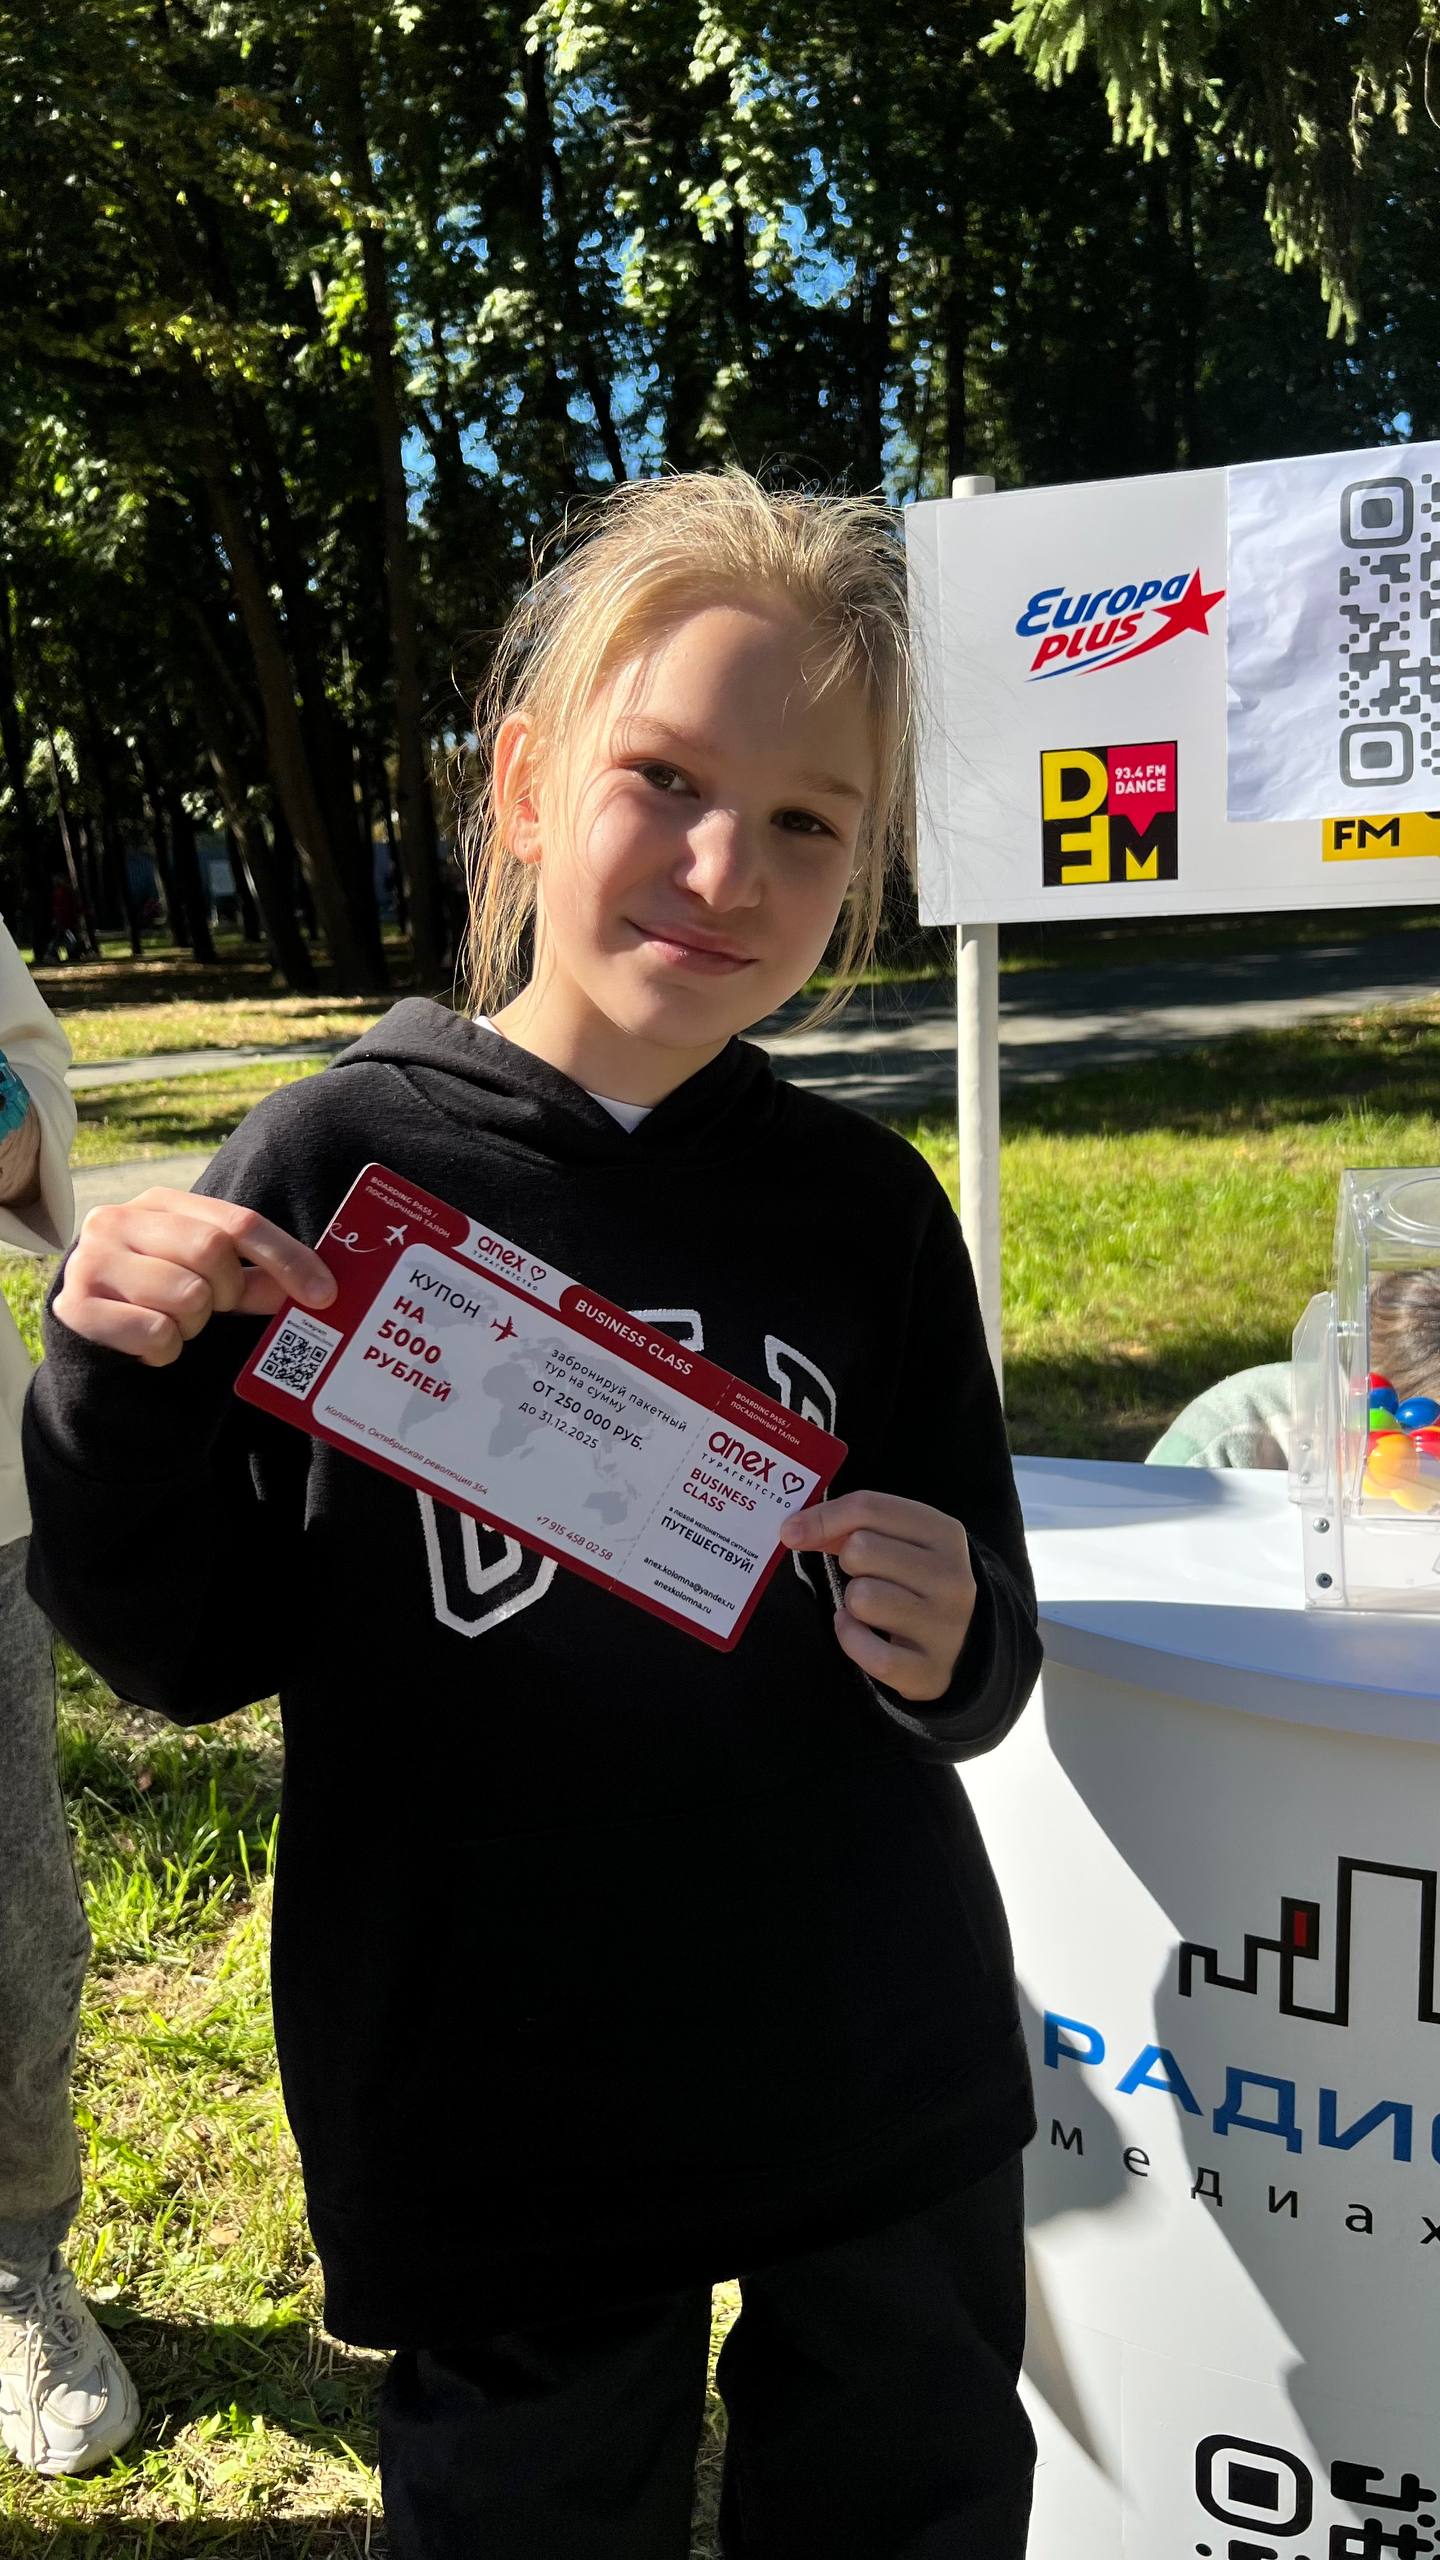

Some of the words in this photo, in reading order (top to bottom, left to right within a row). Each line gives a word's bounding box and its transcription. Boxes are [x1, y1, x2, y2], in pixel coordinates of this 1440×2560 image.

[1114, 766, 1143, 780] 93.4
[1146, 764, 1167, 777] FM
[1115, 778, 1167, 795] DANCE
[1333, 817, 1401, 850] FM
[368, 1174, 414, 1205] BOARDING
[410, 1199, 434, 1217] PASS
[420, 1217, 451, 1239] ТАЛОН
[474, 1233, 528, 1273] anex
[407, 1268, 482, 1319] КУПОН
[470, 1248, 540, 1292] ТУРАГЕНТСТВО
[391, 1293, 430, 1325] НА
[375, 1317, 445, 1367] 5000
[573, 1297, 649, 1349] BUSINESS
[645, 1340, 695, 1377] CLASS
[362, 1340, 455, 1403] РУБЛЕЙ
[541, 1359, 567, 1381] тур
[567, 1374, 586, 1390] на
[584, 1384, 627, 1415] сумму
[548, 1346, 629, 1399] забронируй
[626, 1390, 689, 1433] пакетный
[517, 1399, 539, 1418] до
[536, 1409, 600, 1450] 31.12.2025
[529, 1377, 556, 1400] ОТ
[553, 1390, 584, 1415] 250
[580, 1406, 614, 1432] 000
[611, 1423, 647, 1451] РУБ.
[728, 1399, 779, 1433] ПОСАДОЧНЫЙ
[775, 1427, 801, 1447] ТАЛОН
[733, 1391, 771, 1417] BOARDING
[768, 1411, 788, 1427] PASS
[703, 1426, 779, 1484] anex
[680, 1480, 727, 1514] CLASS
[688, 1466, 759, 1513] BUSINESS
[698, 1451, 794, 1510] ТУРАГЕНТСТВО
[533, 1512, 550, 1527] +7
[546, 1519, 568, 1537] 915
[563, 1528, 587, 1547] 458
[583, 1539, 602, 1555] 02
[596, 1546, 614, 1562] 58
[658, 1512, 756, 1574] ПУТЕШЕСТВУЙ!
[641, 1554, 737, 1612] anex.kolomna@yandex.ru
[652, 1576, 714, 1615] anexkolomna.ru
[1043, 2009, 1440, 2166] РАДИ
